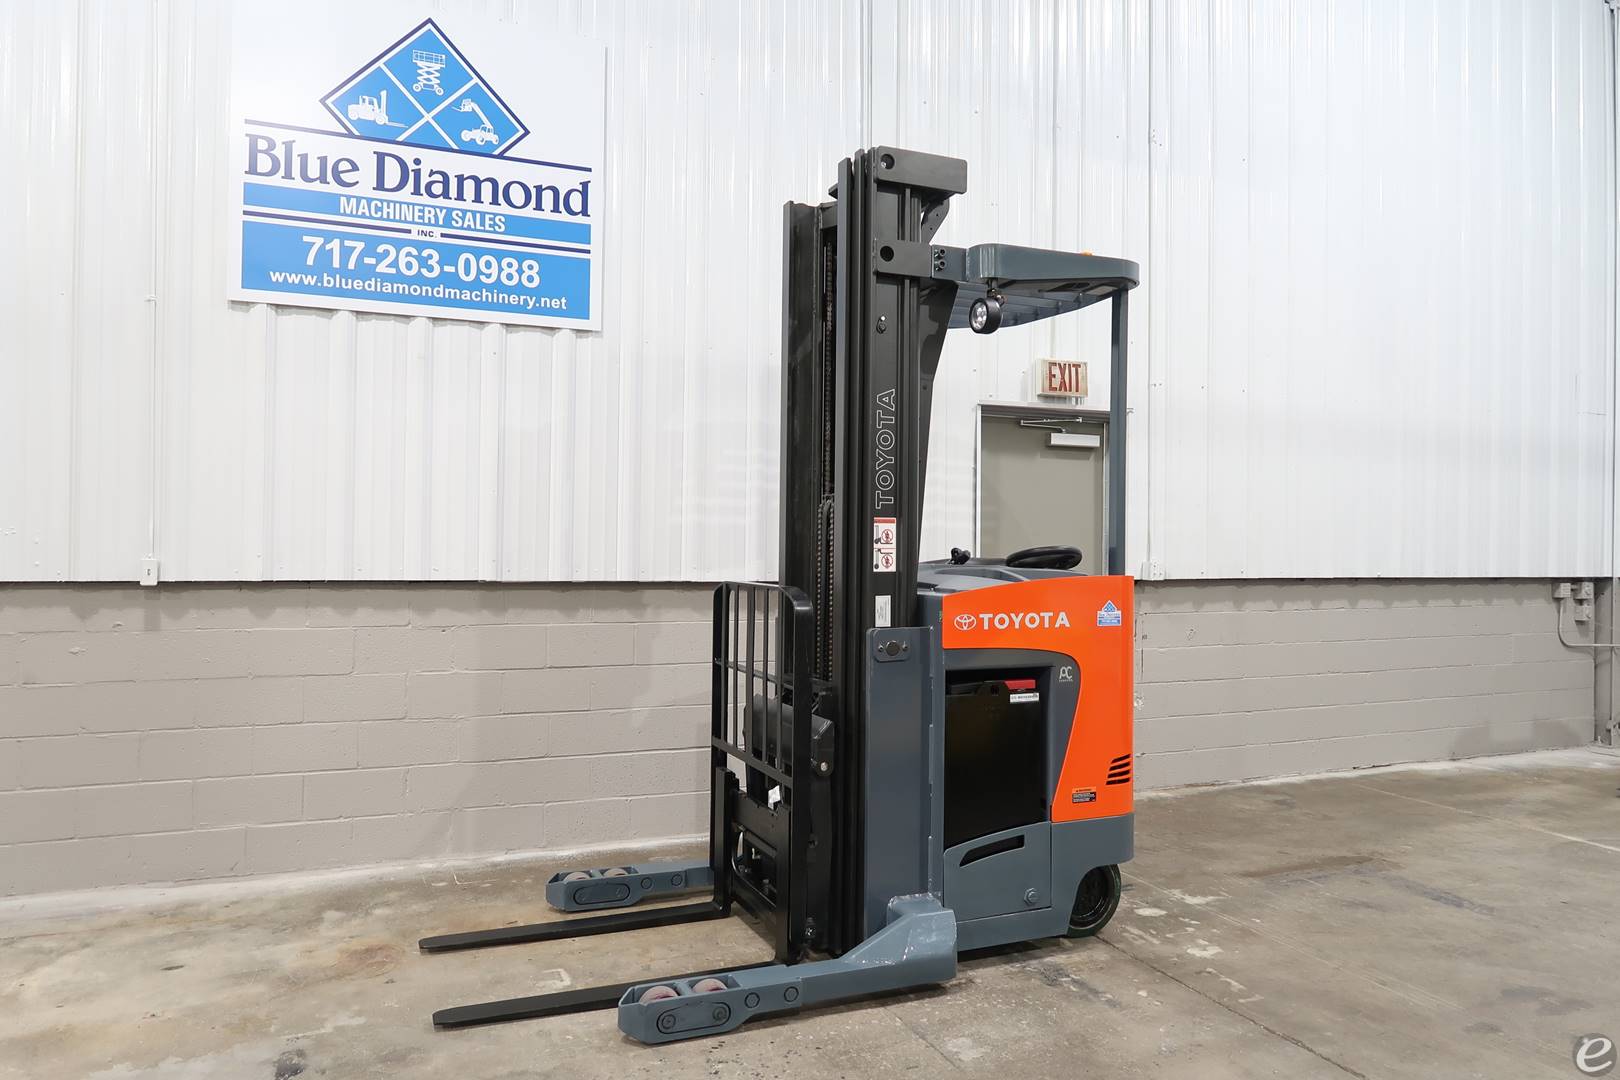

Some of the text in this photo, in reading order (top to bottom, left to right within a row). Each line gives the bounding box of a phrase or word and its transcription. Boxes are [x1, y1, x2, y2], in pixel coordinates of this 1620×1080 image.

[244, 133, 592, 217] Blue Diamond
[339, 196, 506, 232] MACHINERY SALES
[417, 228, 438, 239] INC.
[302, 235, 541, 288] 717-263-0988
[269, 269, 567, 310] www.bluediamondmachinery.net
[1048, 362, 1081, 392] EXIT
[875, 388, 896, 510] TOYOTA
[979, 611, 1071, 630] TOYOTA
